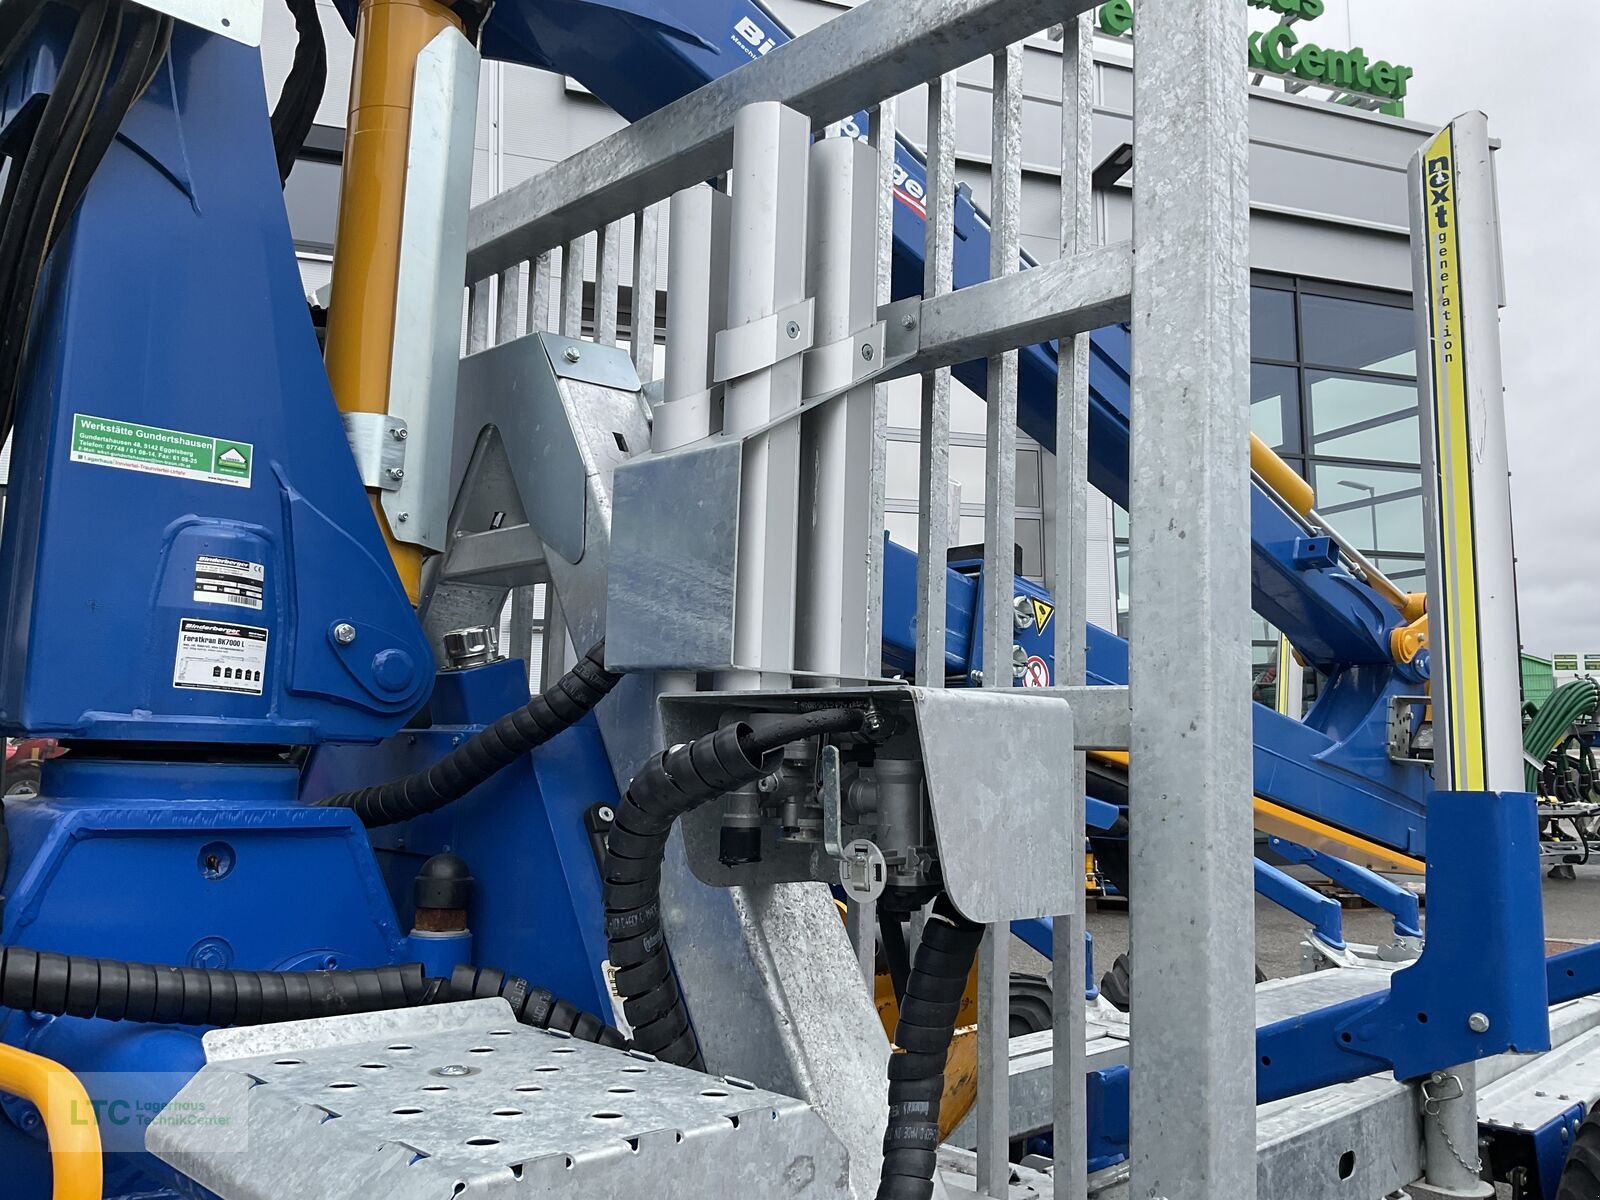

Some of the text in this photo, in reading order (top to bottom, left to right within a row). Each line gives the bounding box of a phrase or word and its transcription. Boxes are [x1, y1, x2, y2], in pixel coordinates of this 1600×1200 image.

[734, 16, 776, 56] Bi
[1438, 232, 1453, 363] generation
[79, 432, 132, 446] Gundertshausen
[143, 442, 158, 451] 5142
[159, 446, 194, 458] Eggelsberg
[80, 419, 213, 449] Werkstätte Gundertshausen
[79, 440, 105, 449] Telefon:
[158, 452, 171, 460] Fax:
[198, 556, 249, 567] Binderberger
[185, 623, 240, 634] Binderberger
[183, 634, 217, 644] Forstkran
[217, 637, 241, 647] BK7000
